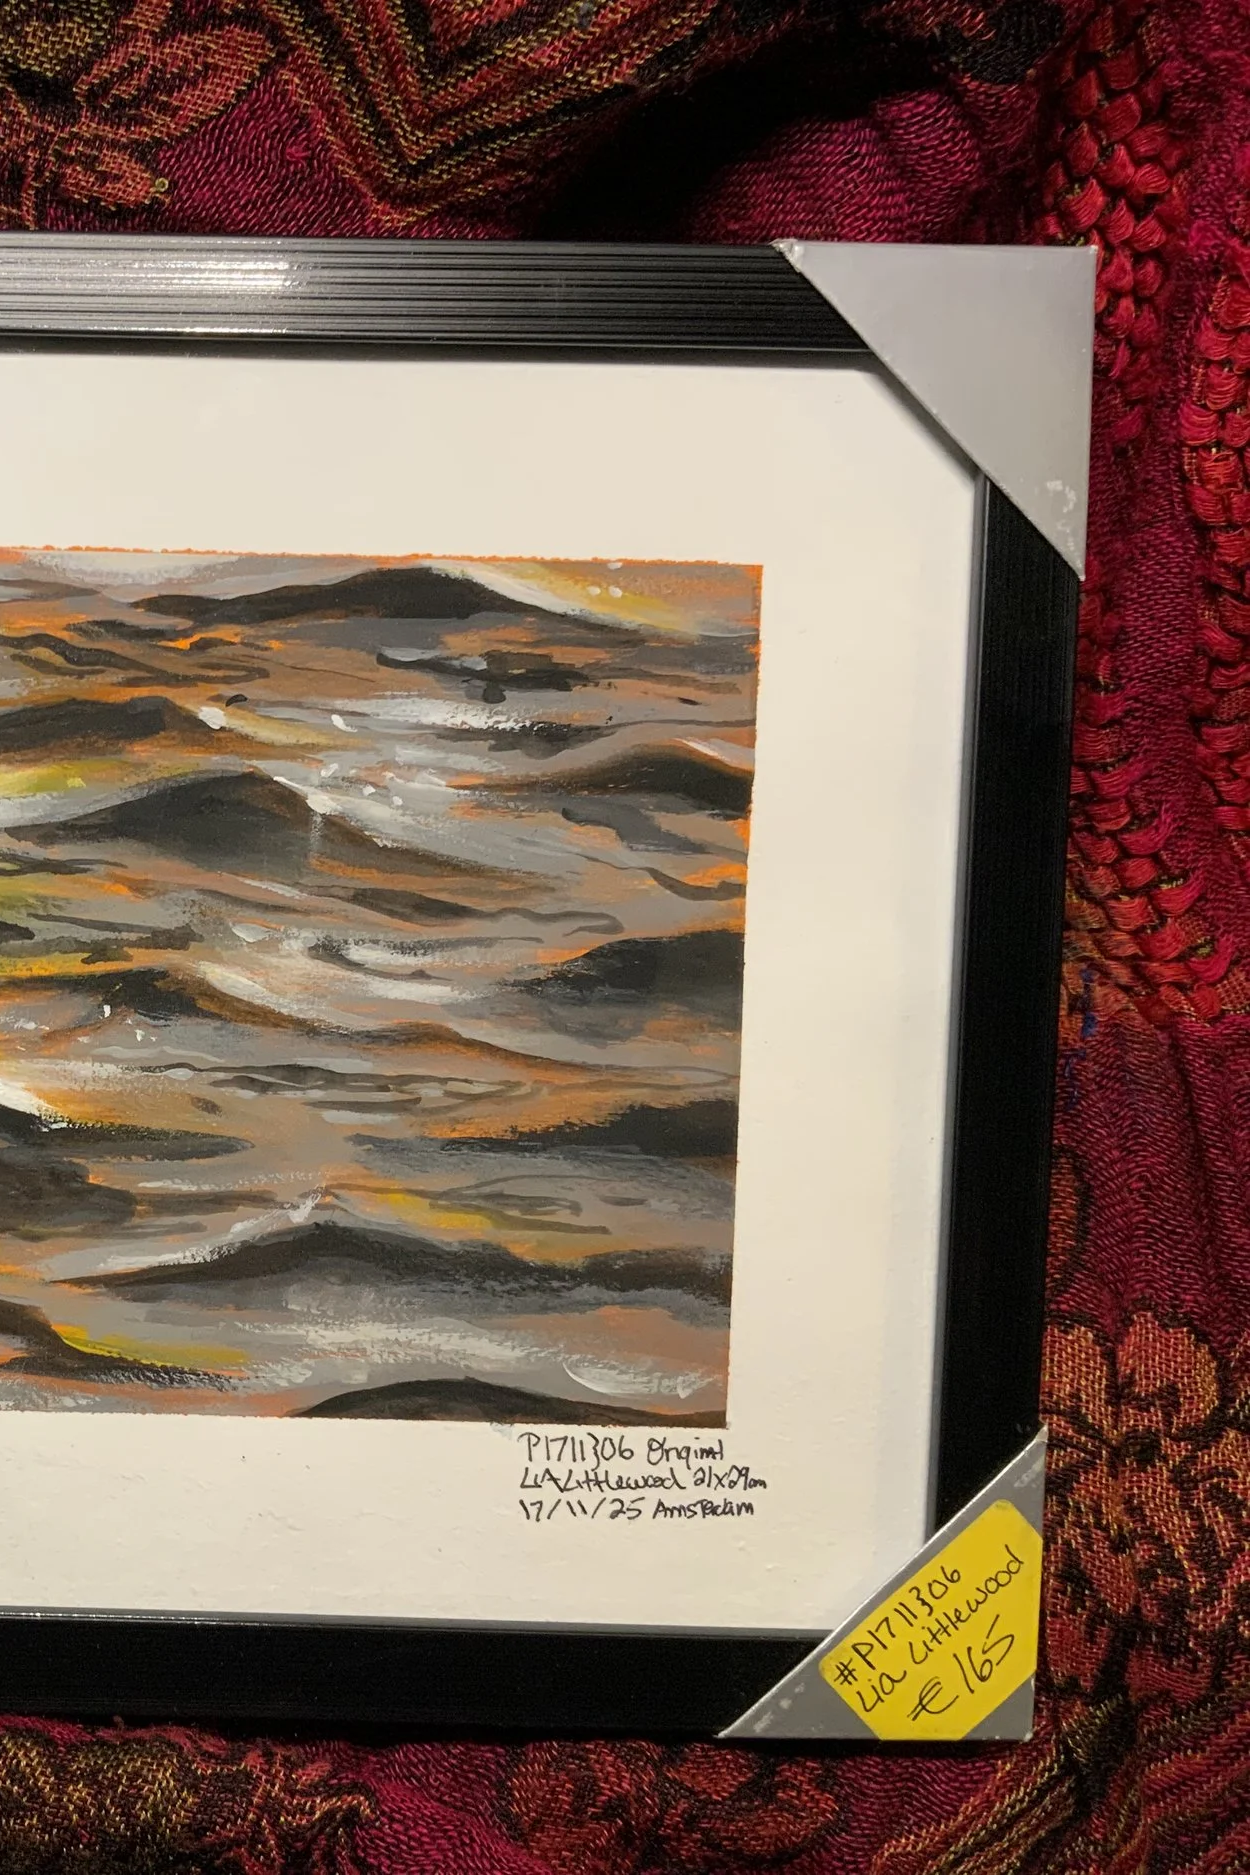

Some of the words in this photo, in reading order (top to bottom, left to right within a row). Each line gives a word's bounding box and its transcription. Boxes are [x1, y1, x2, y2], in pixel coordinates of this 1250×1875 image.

[517, 1432, 634, 1470] P1711306
[519, 1497, 645, 1522] 17/11/25
[909, 1544, 1024, 1665] Littlewood
